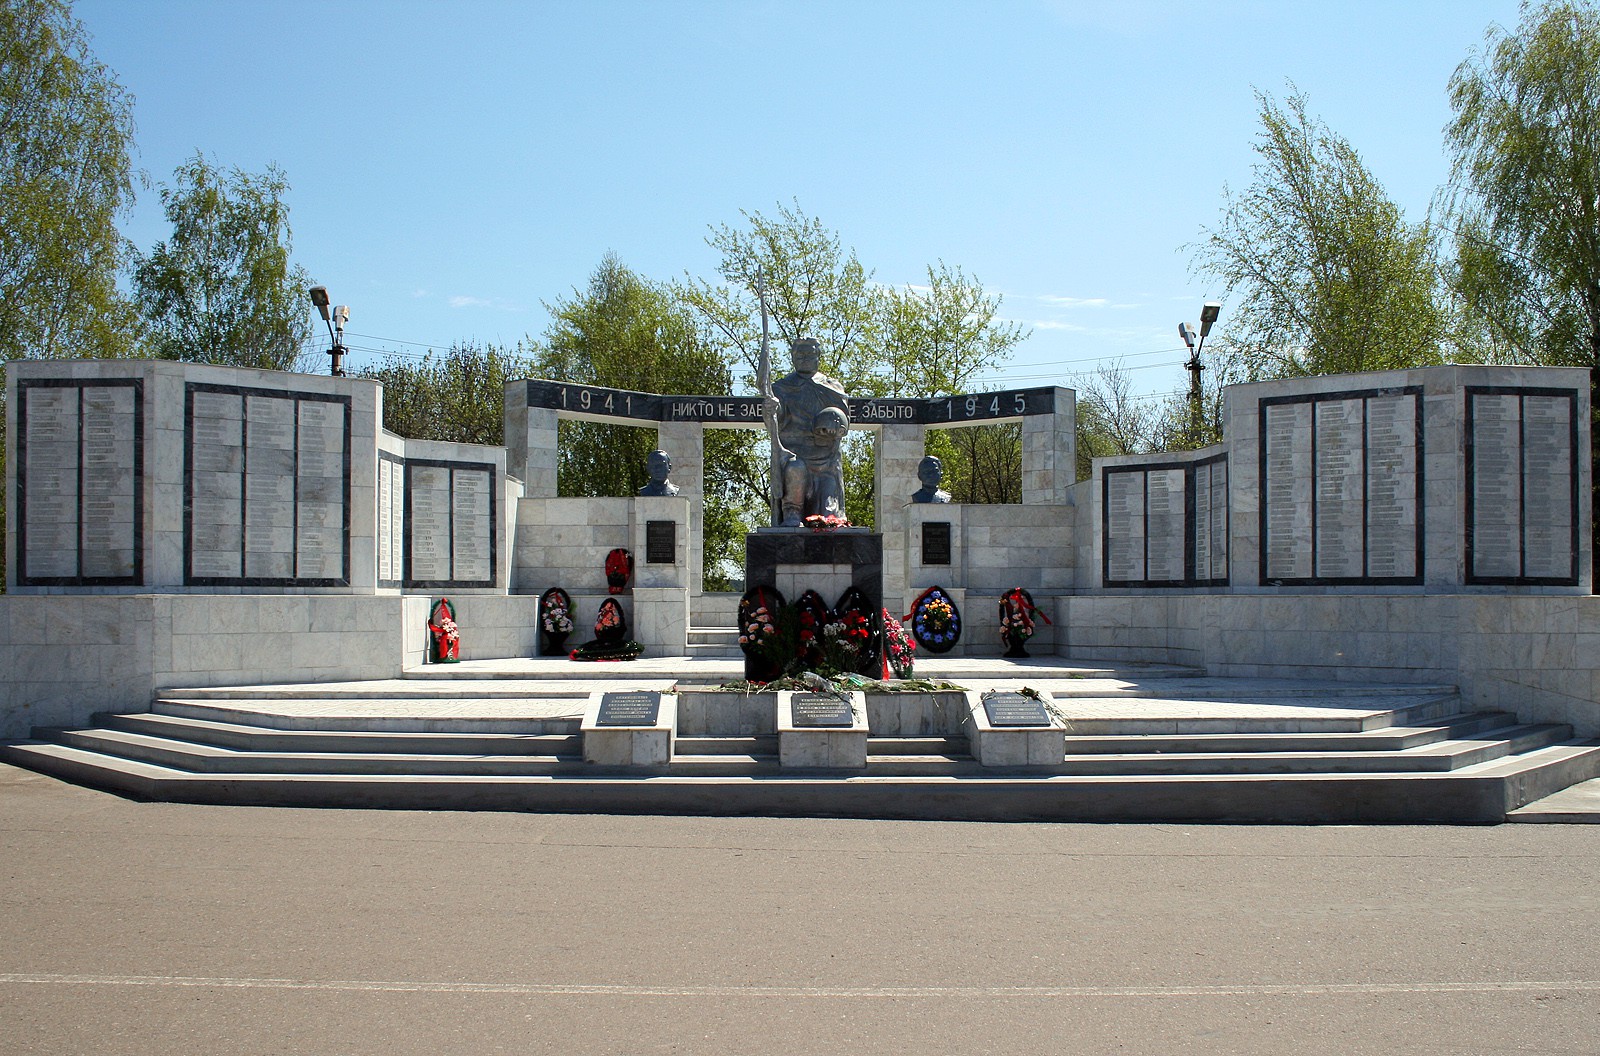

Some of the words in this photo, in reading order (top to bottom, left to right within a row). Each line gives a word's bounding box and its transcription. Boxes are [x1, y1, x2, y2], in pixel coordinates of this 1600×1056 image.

[561, 387, 631, 416] 1941
[672, 402, 714, 417] НИКТО
[718, 403, 736, 417] НЕ
[740, 403, 763, 417] ЗАБ
[848, 404, 857, 418] Е
[862, 405, 913, 419] ЗАБЫТО
[946, 393, 1026, 420] 1945
